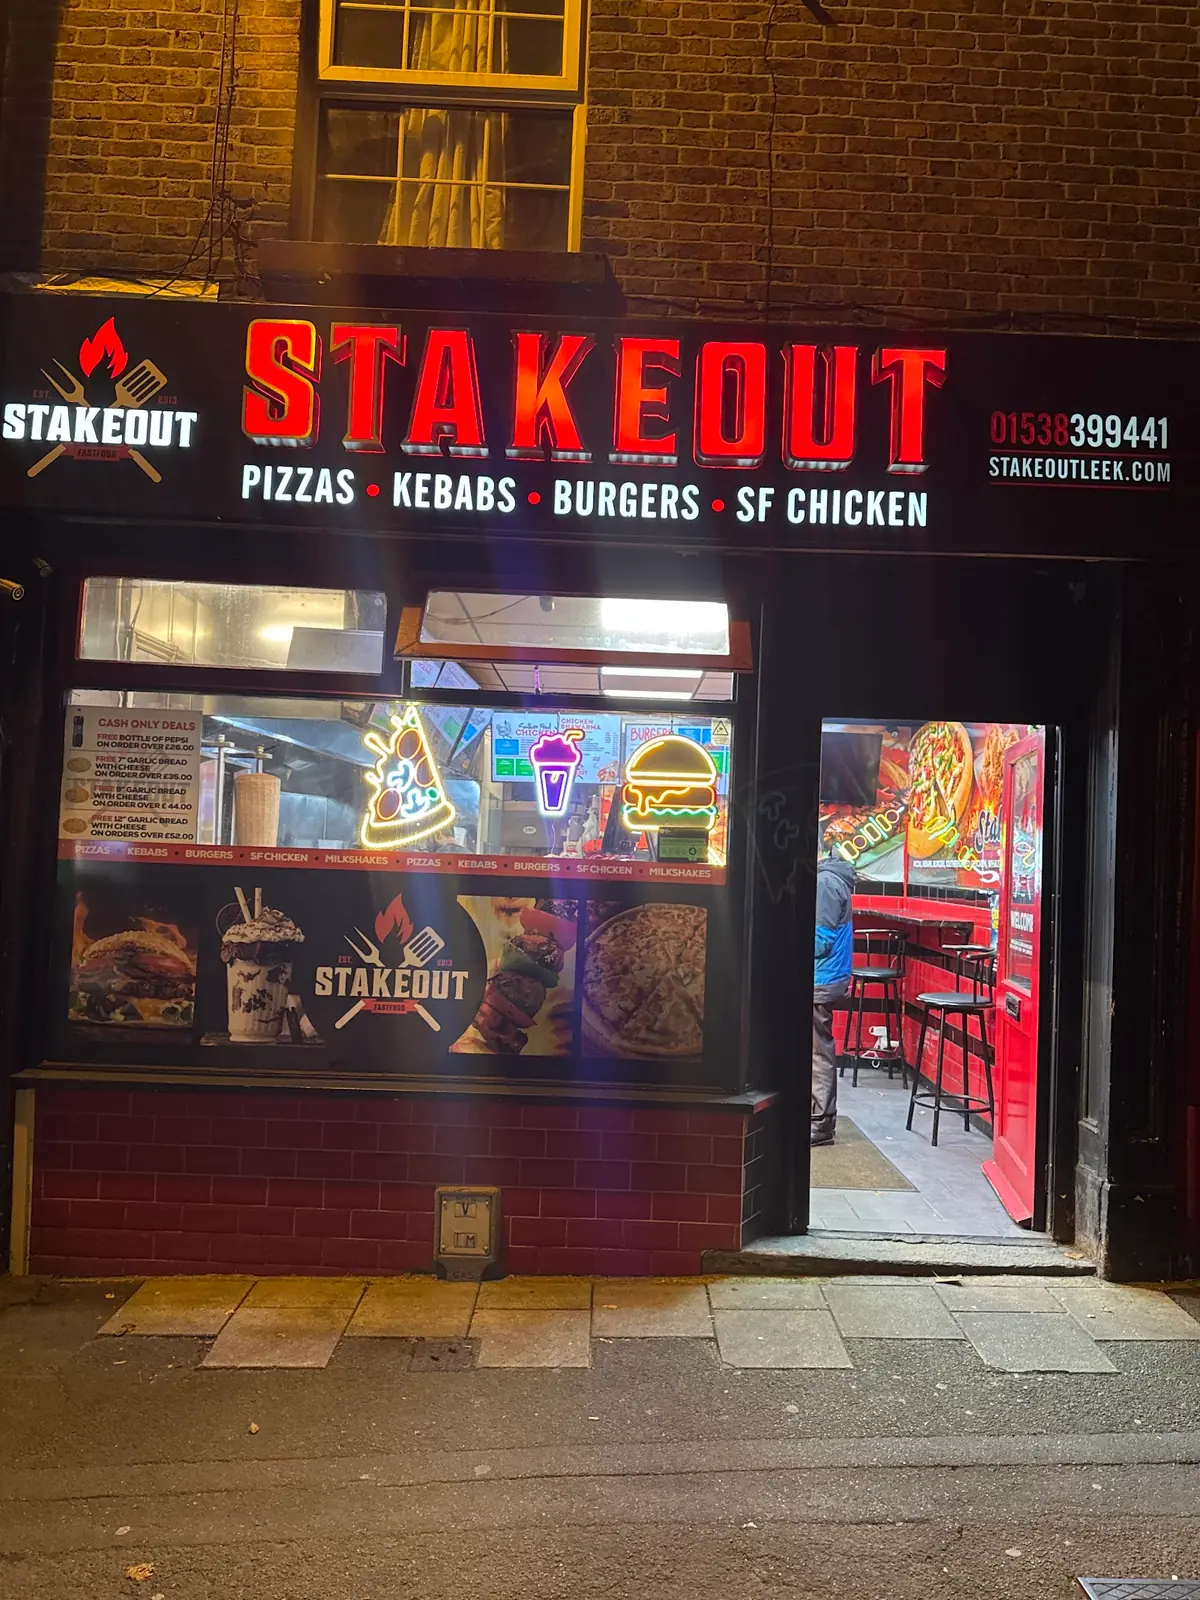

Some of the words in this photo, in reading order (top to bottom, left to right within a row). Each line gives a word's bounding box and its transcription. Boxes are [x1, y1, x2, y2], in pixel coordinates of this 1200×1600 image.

[241, 318, 948, 475] STAKEOUT
[2, 403, 198, 448] STAKEOUT
[989, 456, 1171, 483] STAKEOUTLEEK.COM
[242, 464, 355, 505] PIZZAS
[393, 471, 516, 513] KEBABS
[553, 479, 700, 520] BURGERS
[735, 486, 775, 522] SF
[787, 488, 928, 527] CHICKEN
[98, 718, 128, 728] CASH
[130, 720, 160, 730] ONLY
[162, 721, 195, 731] DEALS
[97, 733, 119, 741] FREE
[119, 734, 151, 742] BOTTLE
[165, 736, 189, 744] PEPSI
[110, 741, 139, 749] ORDER
[141, 742, 164, 750] OVER
[158, 757, 187, 765] BREAD
[138, 772, 162, 780] OVER
[163, 773, 192, 781] £35.00
[126, 786, 157, 794] GARLIC
[157, 787, 186, 795] BREAD
[116, 793, 149, 801] CHEESE
[137, 801, 161, 809] OVER
[127, 816, 158, 824] GARLIC
[159, 817, 188, 825] BREAD
[114, 823, 147, 831] CHEESE
[104, 830, 139, 838] ORDERS
[141, 831, 164, 839] OVER
[165, 832, 194, 840] £52.00
[75, 845, 110, 855] PIZZAS
[127, 847, 168, 857] KEBABS
[185, 850, 233, 860] BURGERS
[250, 851, 263, 861] SF
[264, 852, 308, 862] CHICKEN
[325, 854, 389, 865] MILKSHAKES
[407, 857, 441, 867] PIZZAS
[457, 859, 497, 869] KEBABS
[514, 861, 560, 872] BURGERS
[576, 864, 589, 873] SF
[590, 865, 633, 875] CHICKEN
[649, 867, 711, 878] MILKSHAKES
[338, 955, 353, 964] EST.
[315, 966, 469, 1000] STAKEOUT
[453, 1271, 476, 1280] GAS
